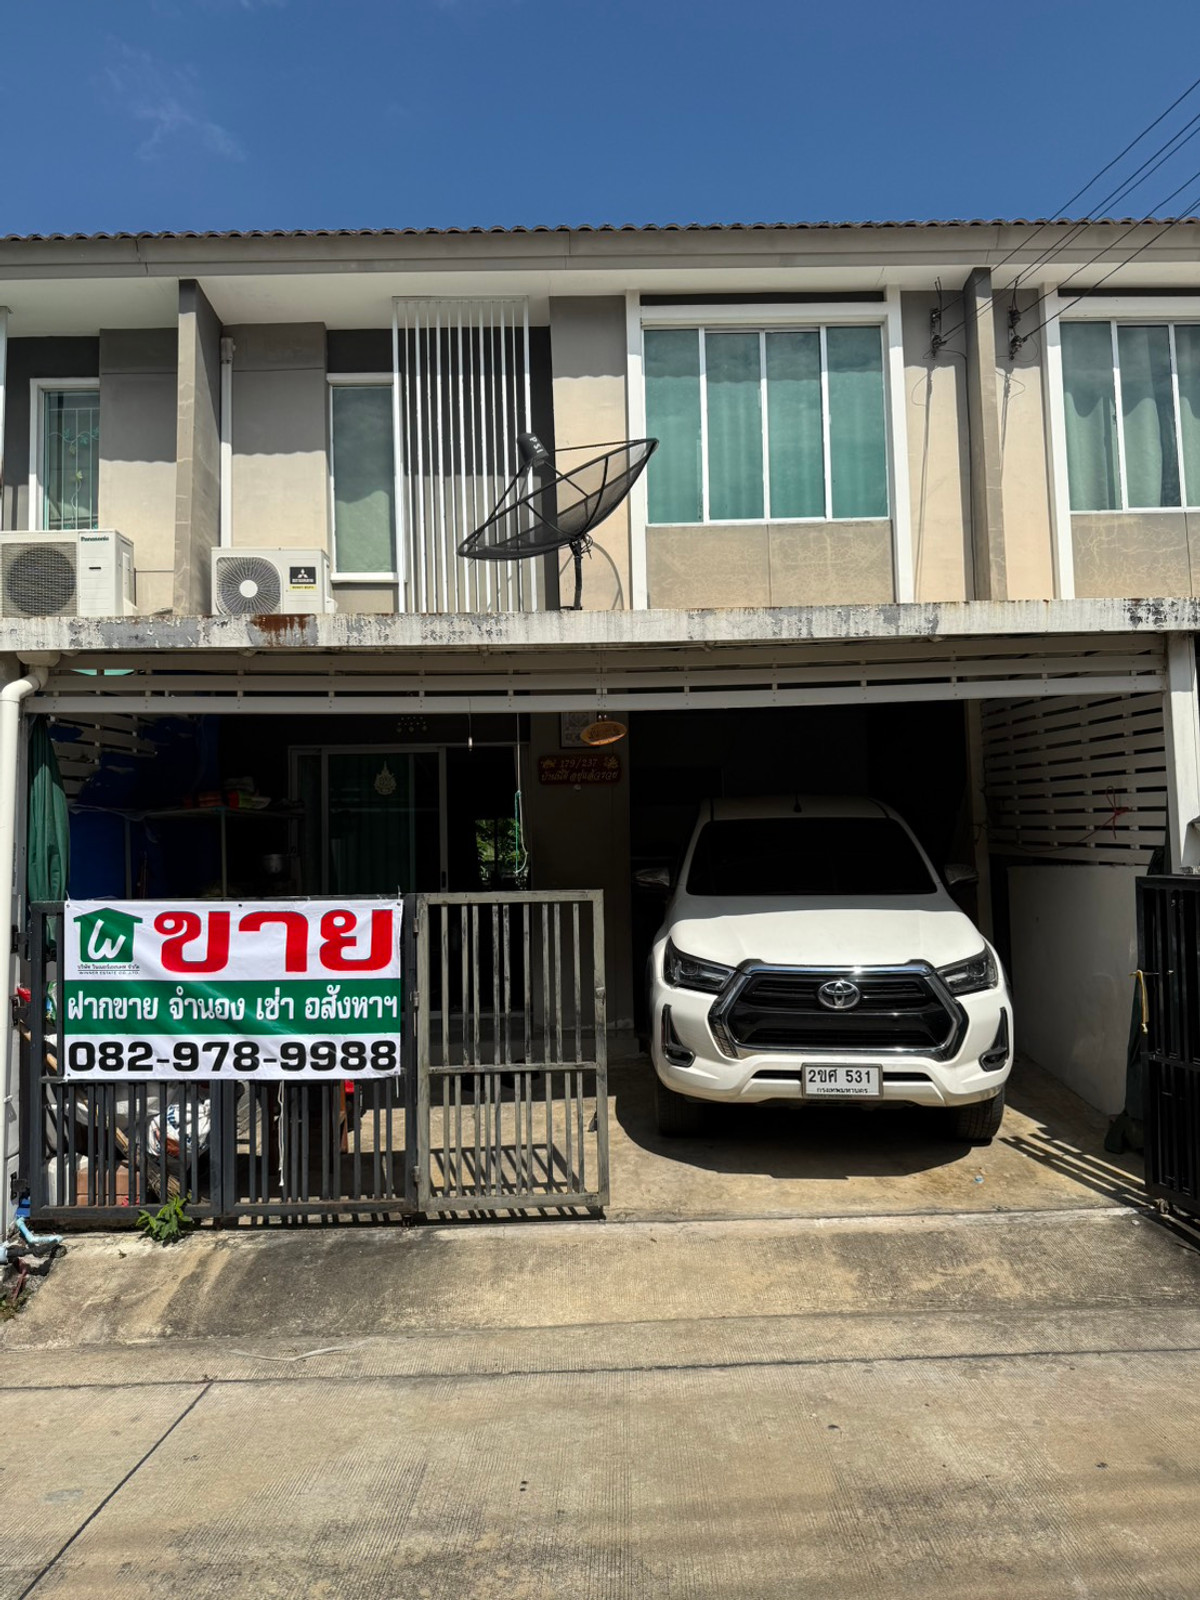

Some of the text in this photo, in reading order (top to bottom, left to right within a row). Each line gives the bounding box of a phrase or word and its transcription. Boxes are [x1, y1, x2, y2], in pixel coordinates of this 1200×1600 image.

[529, 436, 544, 454] PSI
[154, 909, 394, 973] ขาย
[68, 984, 398, 1020] ฝากขาย จำนอง เช่า อสังหาฯ
[68, 1040, 397, 1073] 082-978-9988
[808, 1068, 871, 1083] 2ขศ 531
